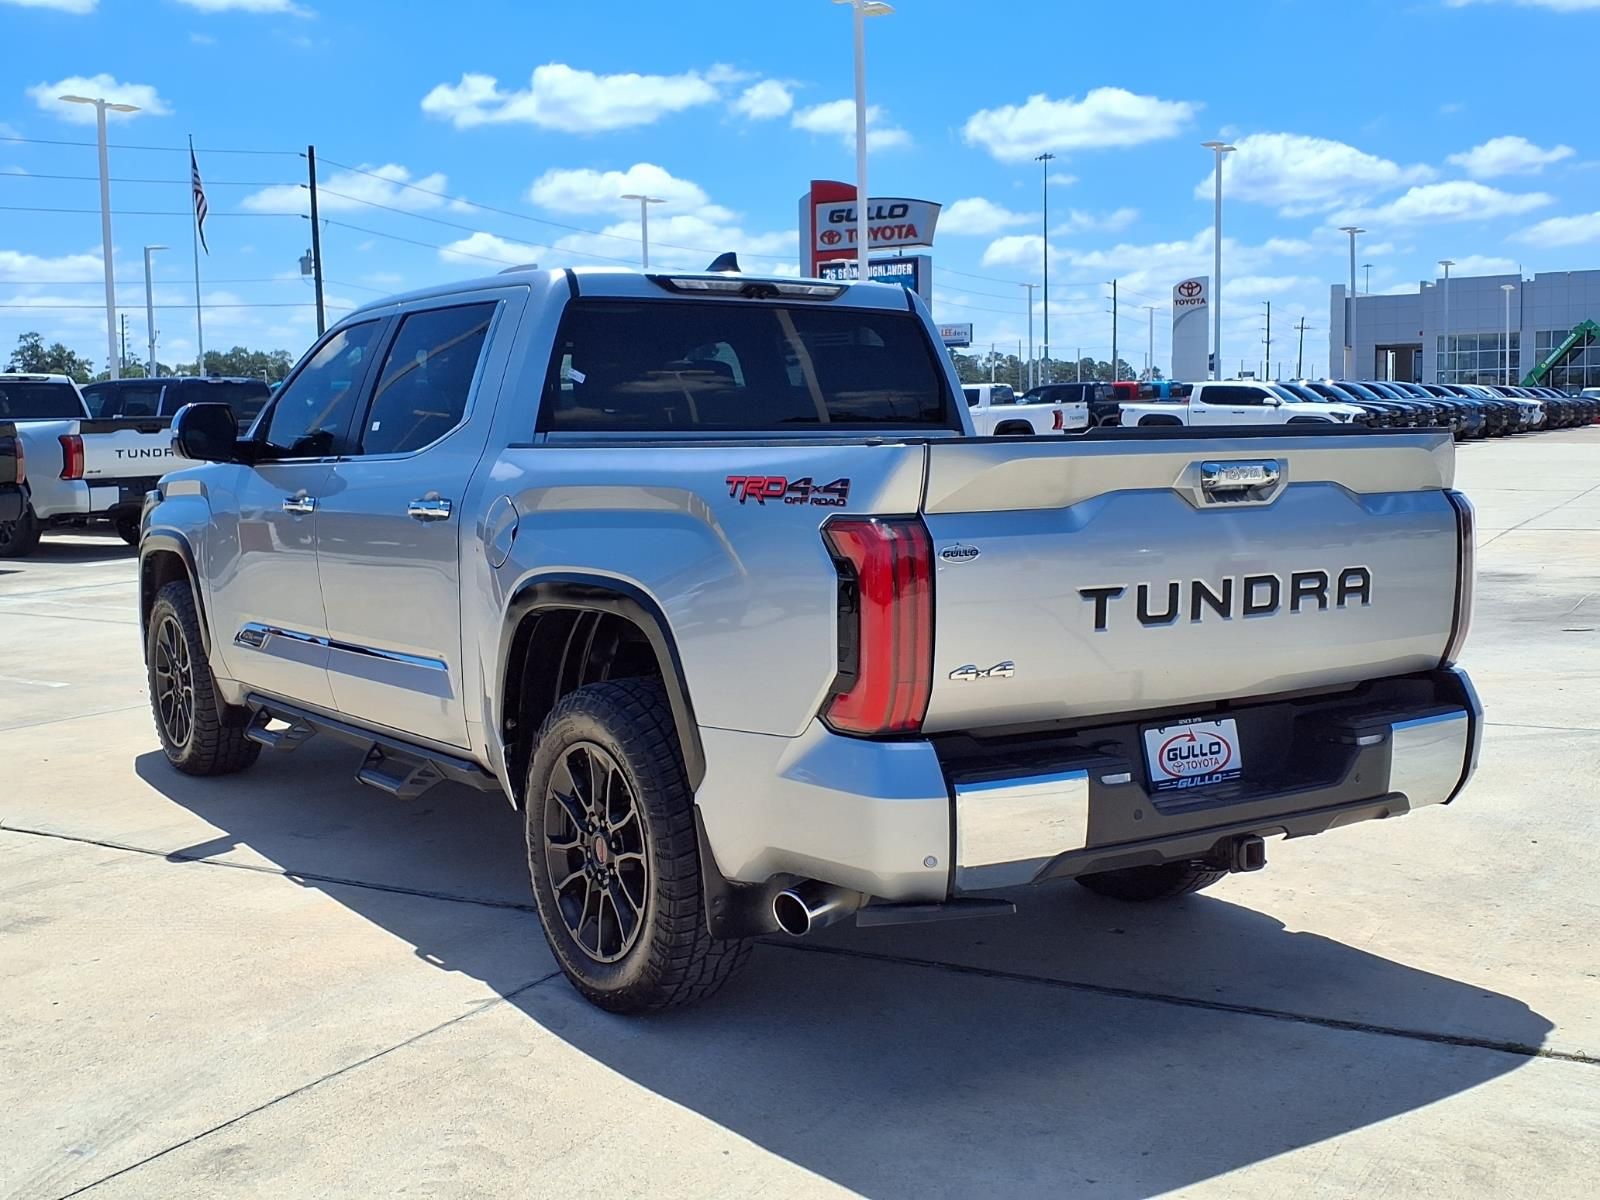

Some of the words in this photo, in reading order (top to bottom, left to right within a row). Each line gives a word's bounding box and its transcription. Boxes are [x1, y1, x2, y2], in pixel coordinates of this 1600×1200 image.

[1174, 297, 1206, 306] TOYOTA
[115, 447, 175, 459] TUNDR
[726, 476, 788, 505] TRD
[784, 496, 809, 505] OFF
[810, 497, 847, 507] ROAD
[942, 548, 979, 559] GULLO
[1076, 564, 1373, 632] TUNDRA
[949, 660, 1015, 681] 4x4
[1166, 741, 1222, 762] GULLO
[1186, 757, 1220, 770] TOYOTA
[1177, 773, 1222, 789] GULLO
